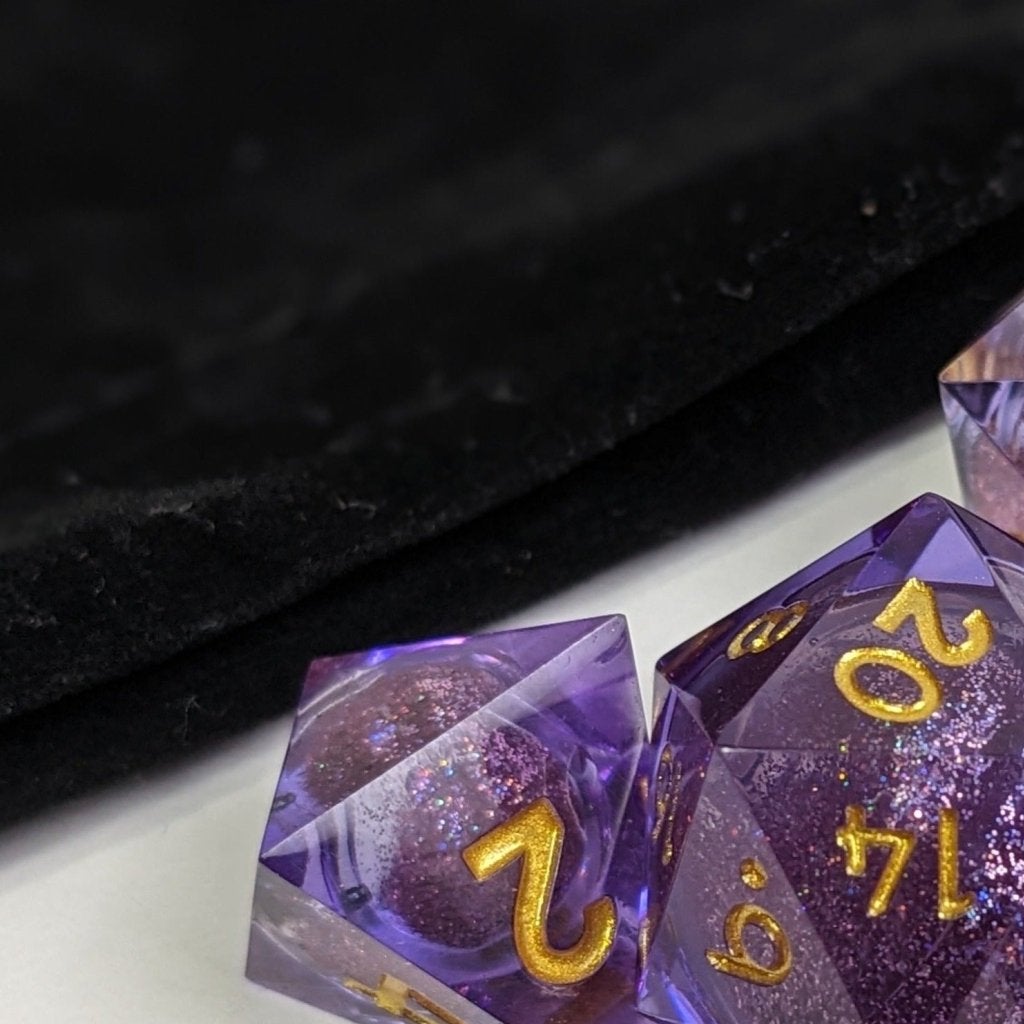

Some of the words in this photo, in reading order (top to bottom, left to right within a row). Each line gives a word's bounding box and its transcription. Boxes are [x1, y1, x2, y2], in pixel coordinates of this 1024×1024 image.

[833, 577, 993, 723] 20
[461, 797, 616, 984] 2
[837, 805, 975, 919] 14
